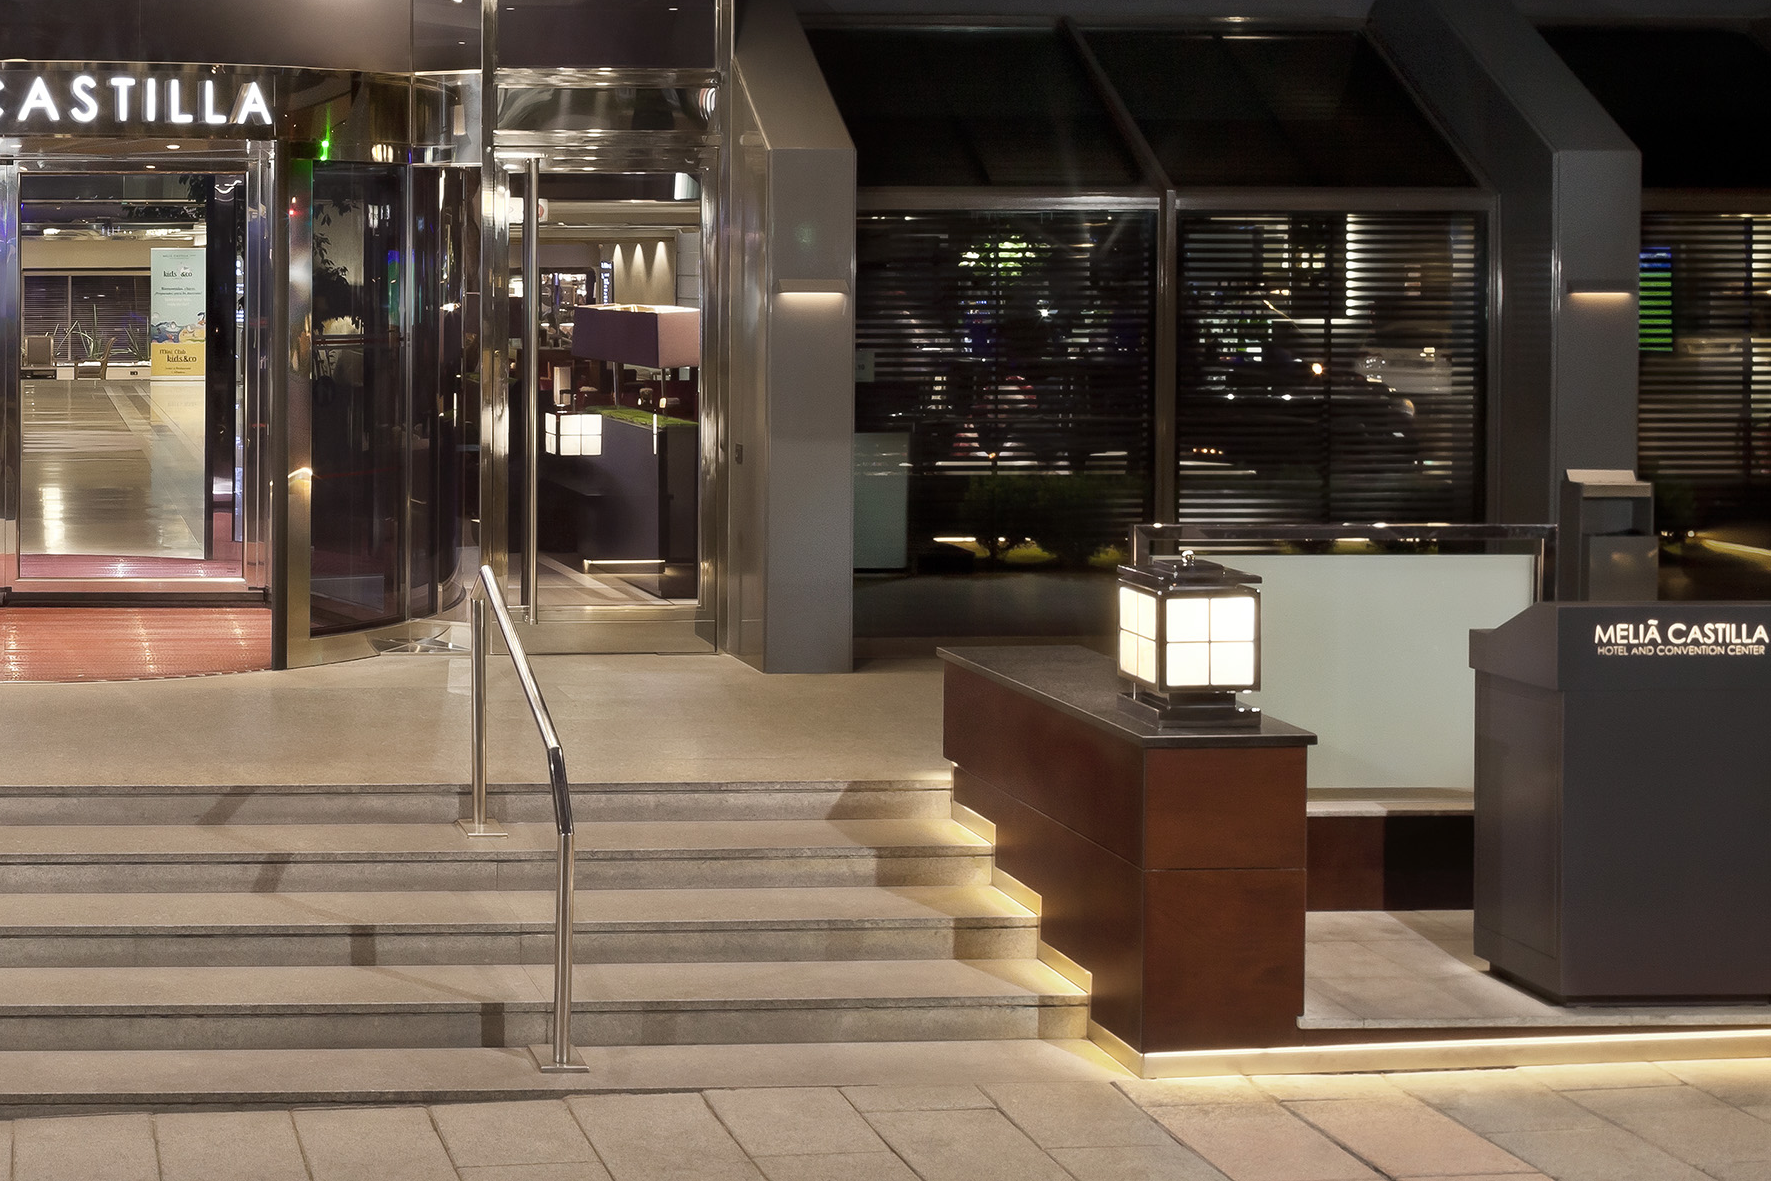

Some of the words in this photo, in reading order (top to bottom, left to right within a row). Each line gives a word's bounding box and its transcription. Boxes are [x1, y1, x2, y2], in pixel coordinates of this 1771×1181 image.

[1594, 619, 1662, 644] MELIÃ
[1667, 623, 1770, 644] CASTILLA
[1597, 645, 1629, 655] HOTEL
[1631, 645, 1655, 655] AND
[1656, 645, 1726, 655] CONVENTION
[1727, 645, 1766, 655] CENTER
